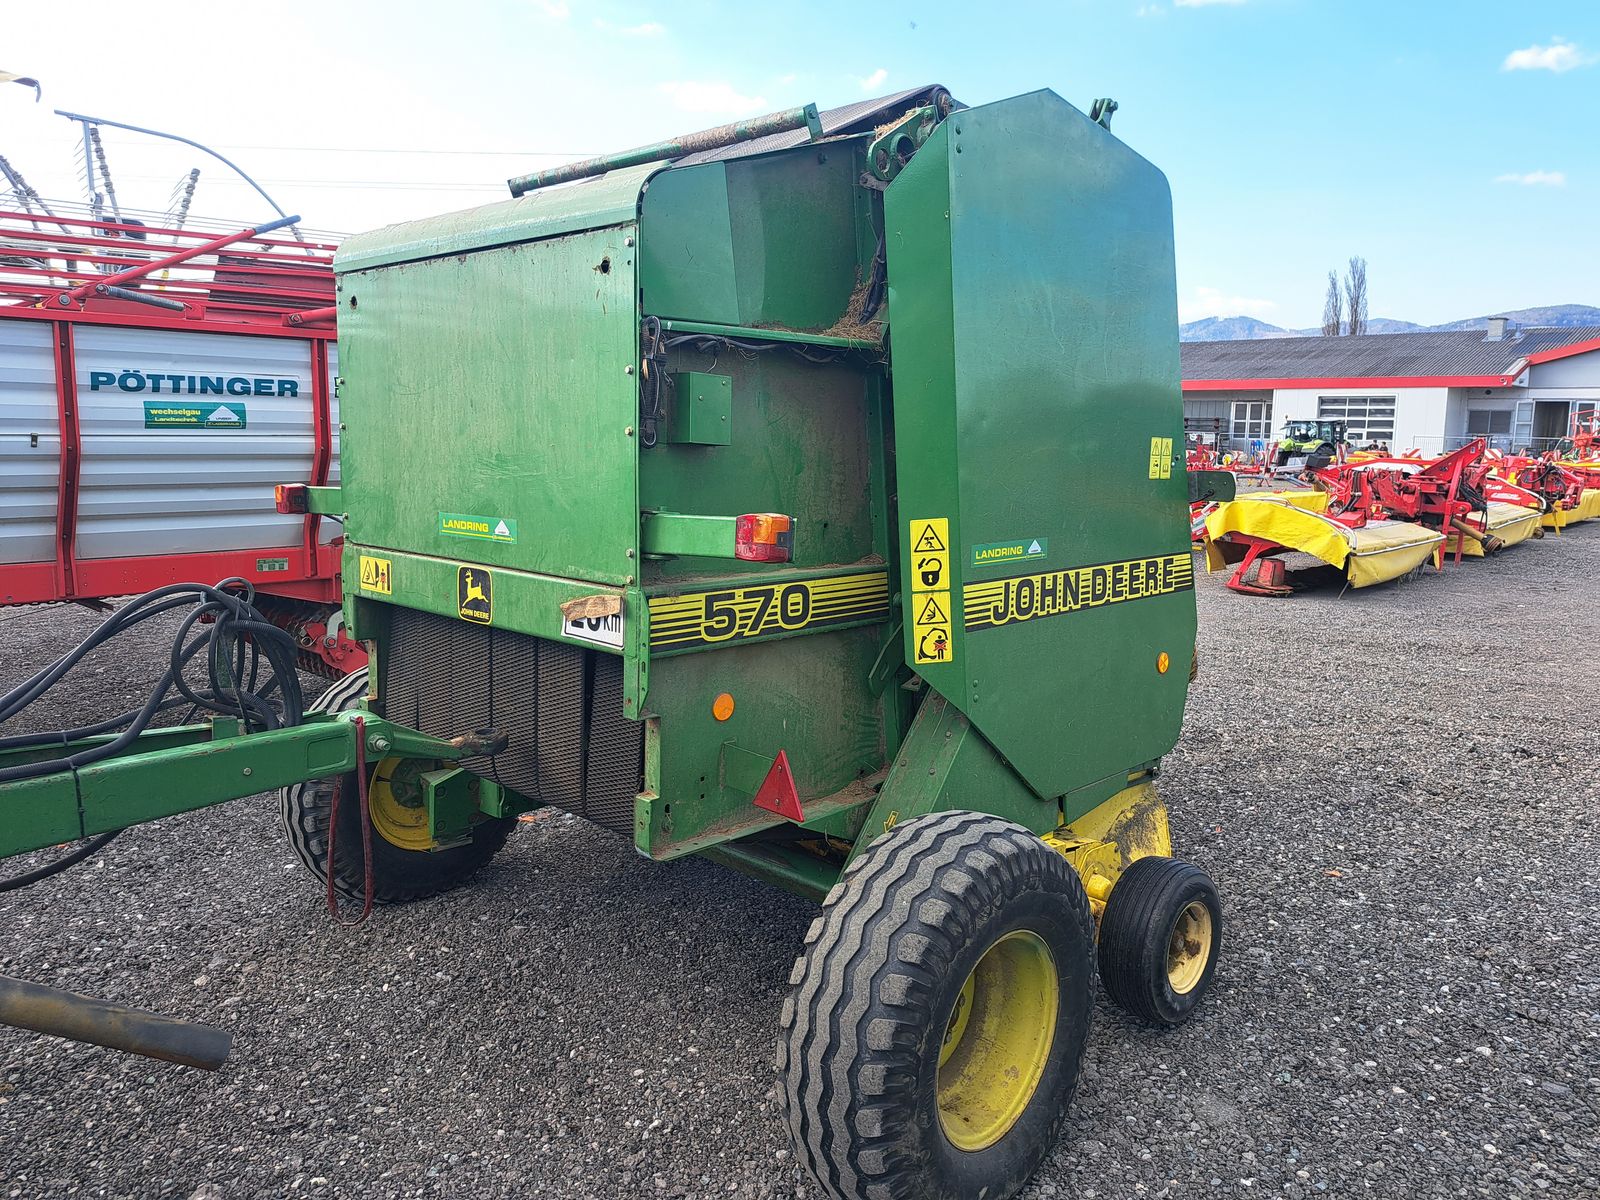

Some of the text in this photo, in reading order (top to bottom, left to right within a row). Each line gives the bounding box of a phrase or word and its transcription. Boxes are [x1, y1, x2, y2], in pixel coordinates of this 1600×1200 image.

[90, 370, 299, 397] PÖTTINGER
[150, 408, 201, 417] wechselgau
[442, 519, 489, 533] LANDRING
[975, 546, 1023, 560] LANDRING
[992, 557, 1175, 622] JOHN DEERE
[460, 607, 490, 620] JOHN DEERE
[703, 583, 810, 638] 570
